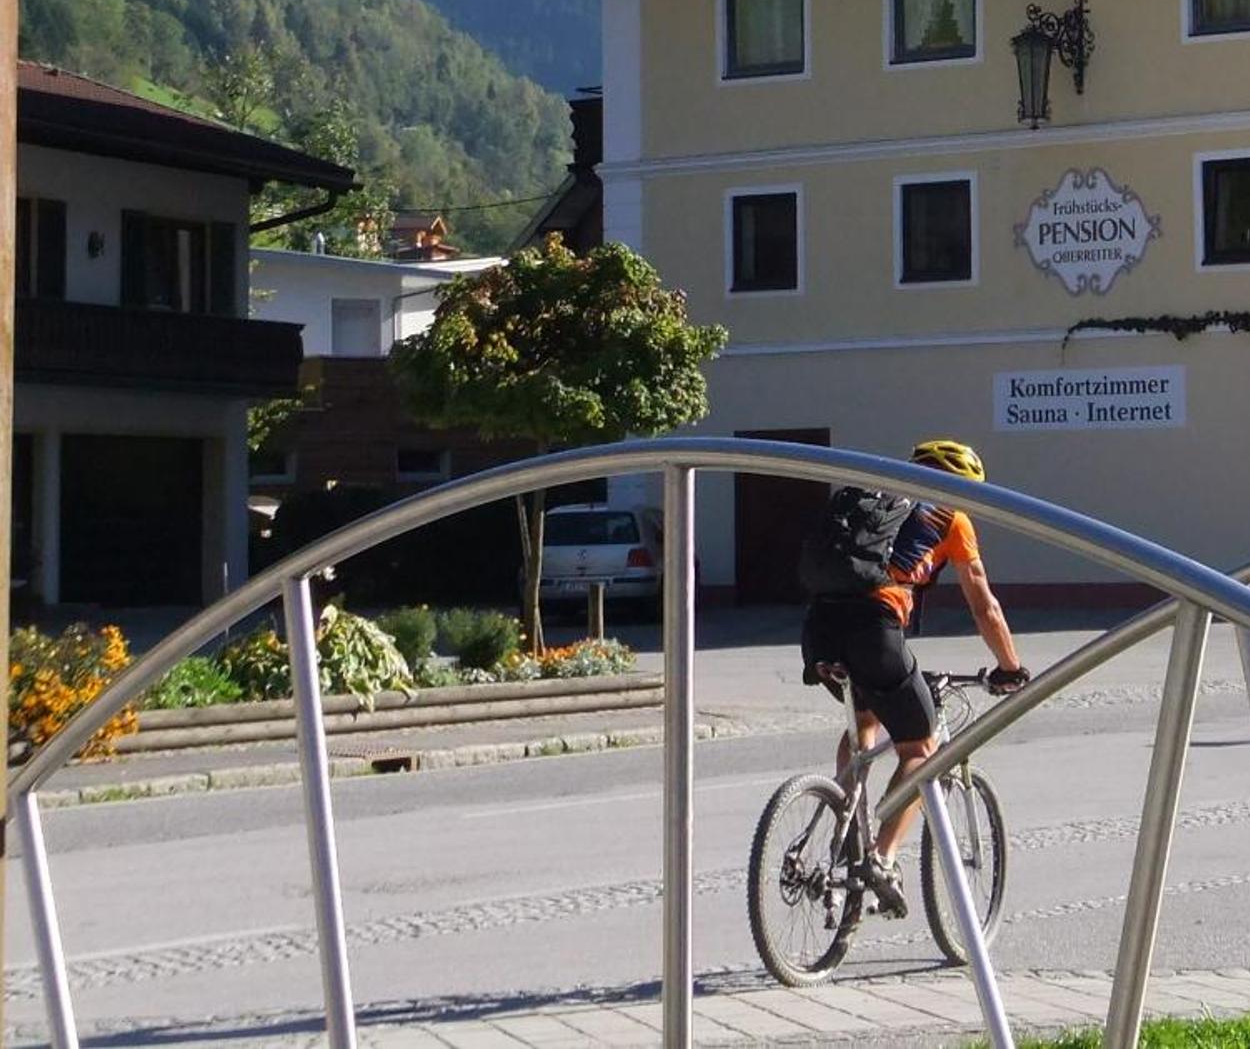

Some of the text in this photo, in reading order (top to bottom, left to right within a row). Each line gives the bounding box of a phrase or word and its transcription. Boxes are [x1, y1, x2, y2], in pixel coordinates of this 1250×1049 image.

[1039, 218, 1136, 245] PENSION
[1053, 248, 1122, 263] OBERREITER
[1010, 376, 1170, 398] Komfortzimmer
[1007, 402, 1172, 424] Sauna Internet
